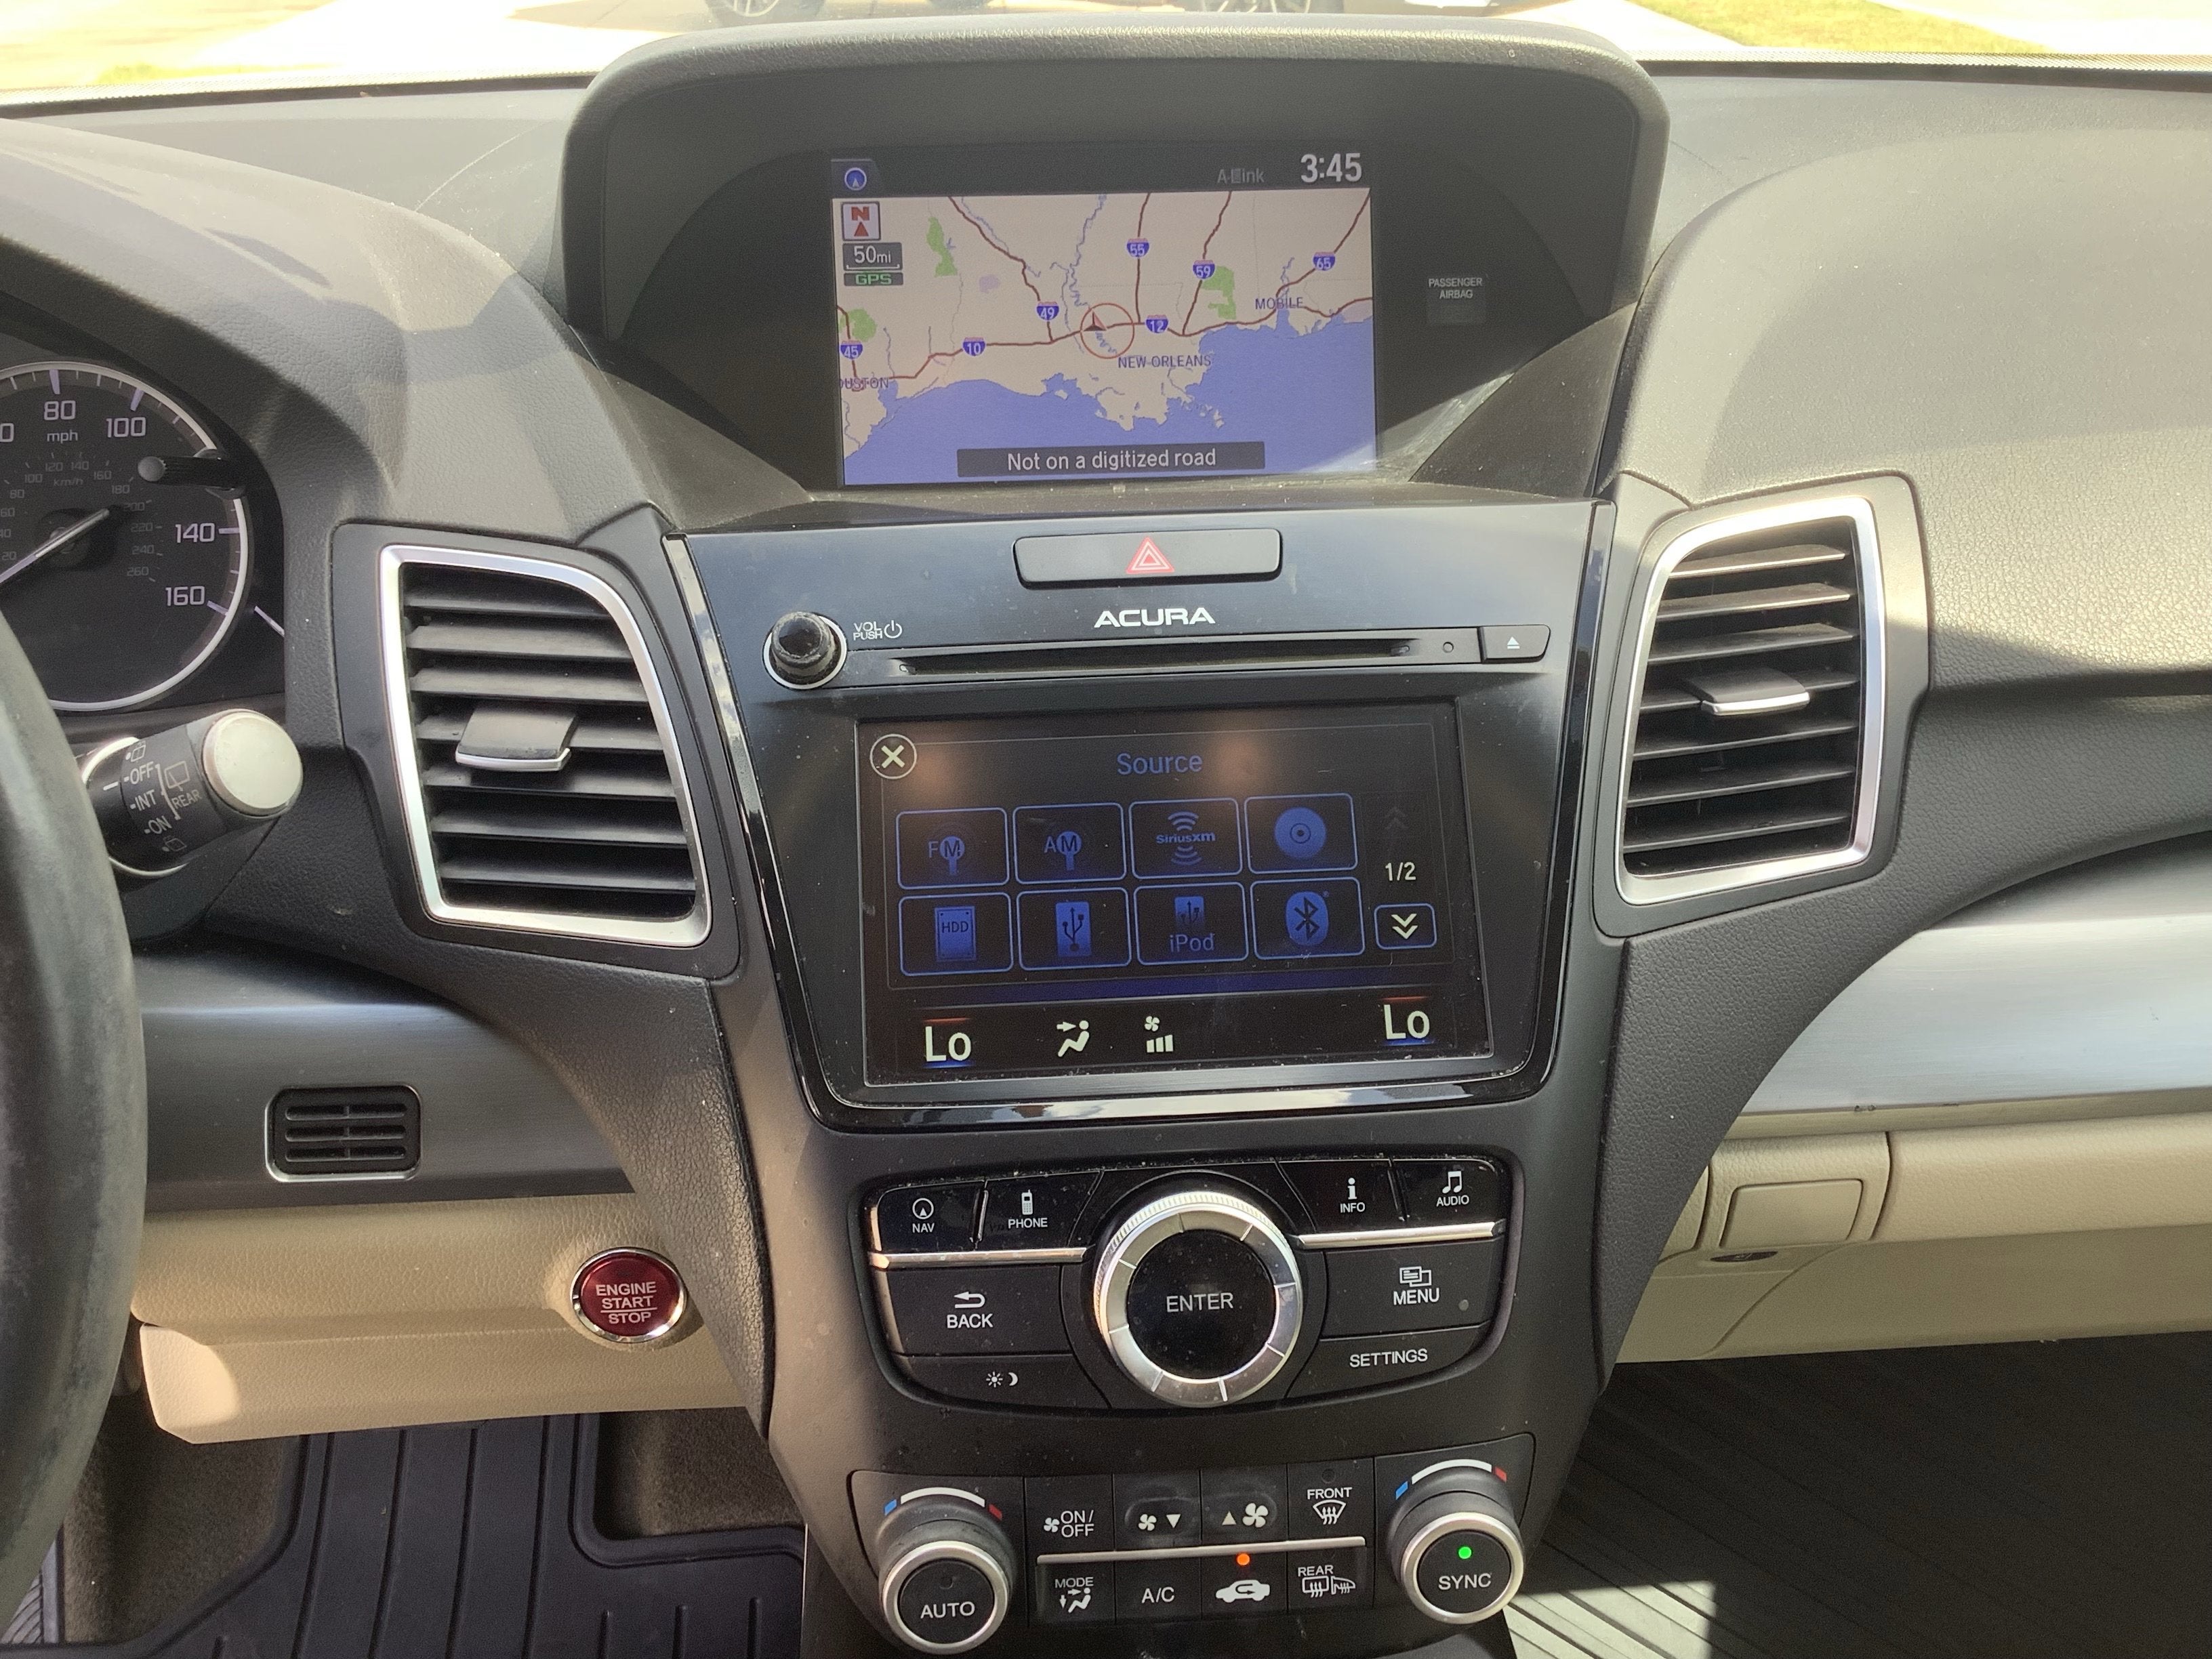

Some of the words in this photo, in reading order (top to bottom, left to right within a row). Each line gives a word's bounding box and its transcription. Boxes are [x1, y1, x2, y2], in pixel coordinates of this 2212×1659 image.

[1300, 152, 1362, 183] 3:45
[851, 206, 870, 221] N
[1130, 243, 1145, 256] 55
[1316, 258, 1332, 270] 65
[1196, 264, 1212, 278] 59
[855, 273, 892, 285] GPS
[1428, 277, 1483, 287] PASSENGER
[1439, 289, 1473, 299] AIRBAG
[1254, 297, 1304, 310] MOBILE
[1040, 307, 1055, 320] 49
[1149, 320, 1165, 333] 12
[844, 346, 859, 358] 45
[967, 343, 981, 355] 10
[1118, 356, 1146, 369] NEW
[1151, 355, 1212, 368] ORLEANS
[44, 400, 76, 420] 80
[106, 417, 146, 438] 100
[47, 430, 79, 444] mph
[70, 461, 89, 470] 140
[1007, 452, 1040, 471] Not
[1046, 454, 1069, 470] on
[1075, 455, 1086, 470] a
[1092, 449, 1170, 471] digitized
[1174, 448, 1216, 466] road
[45, 462, 63, 472] 120
[24, 474, 43, 483] 100
[94, 470, 112, 480] 160
[54, 477, 83, 487] km/h
[111, 485, 130, 494] 180
[130, 523, 152, 532] 220
[176, 522, 216, 544] 140
[127, 567, 149, 576] 260
[165, 586, 205, 606] 160
[1094, 607, 1215, 628] ACURA
[853, 621, 882, 632] VOL
[853, 630, 883, 641] PUSH
[1117, 752, 1203, 775] Source
[173, 789, 201, 809] REAR
[1044, 836, 1078, 854] AM
[1385, 861, 1416, 881] 1/2
[941, 920, 969, 934] HDD
[1170, 933, 1214, 952] iPod
[1384, 1003, 1431, 1040] Lo
[924, 1025, 972, 1063] Lo
[1436, 1194, 1469, 1207] AUDIO
[1340, 1201, 1366, 1214] INFO
[912, 1223, 935, 1233] NAV
[1008, 1217, 1048, 1229] PHONE
[596, 1282, 657, 1296] ENGINE
[601, 1296, 653, 1309] START
[1166, 1292, 1233, 1313] ENTER
[1393, 1288, 1440, 1306] MENU
[608, 1312, 651, 1324] STOP
[947, 1313, 994, 1329] BACK
[1349, 1349, 1428, 1368] SETTINGS
[1307, 1487, 1352, 1500] FRONT
[1061, 1523, 1094, 1538] OFF
[1298, 1564, 1334, 1576] REAR
[1054, 1576, 1094, 1589] MODE
[1438, 1573, 1492, 1590] SYNC
[1141, 1586, 1175, 1603] A/C
[920, 1601, 976, 1619] AUTO
